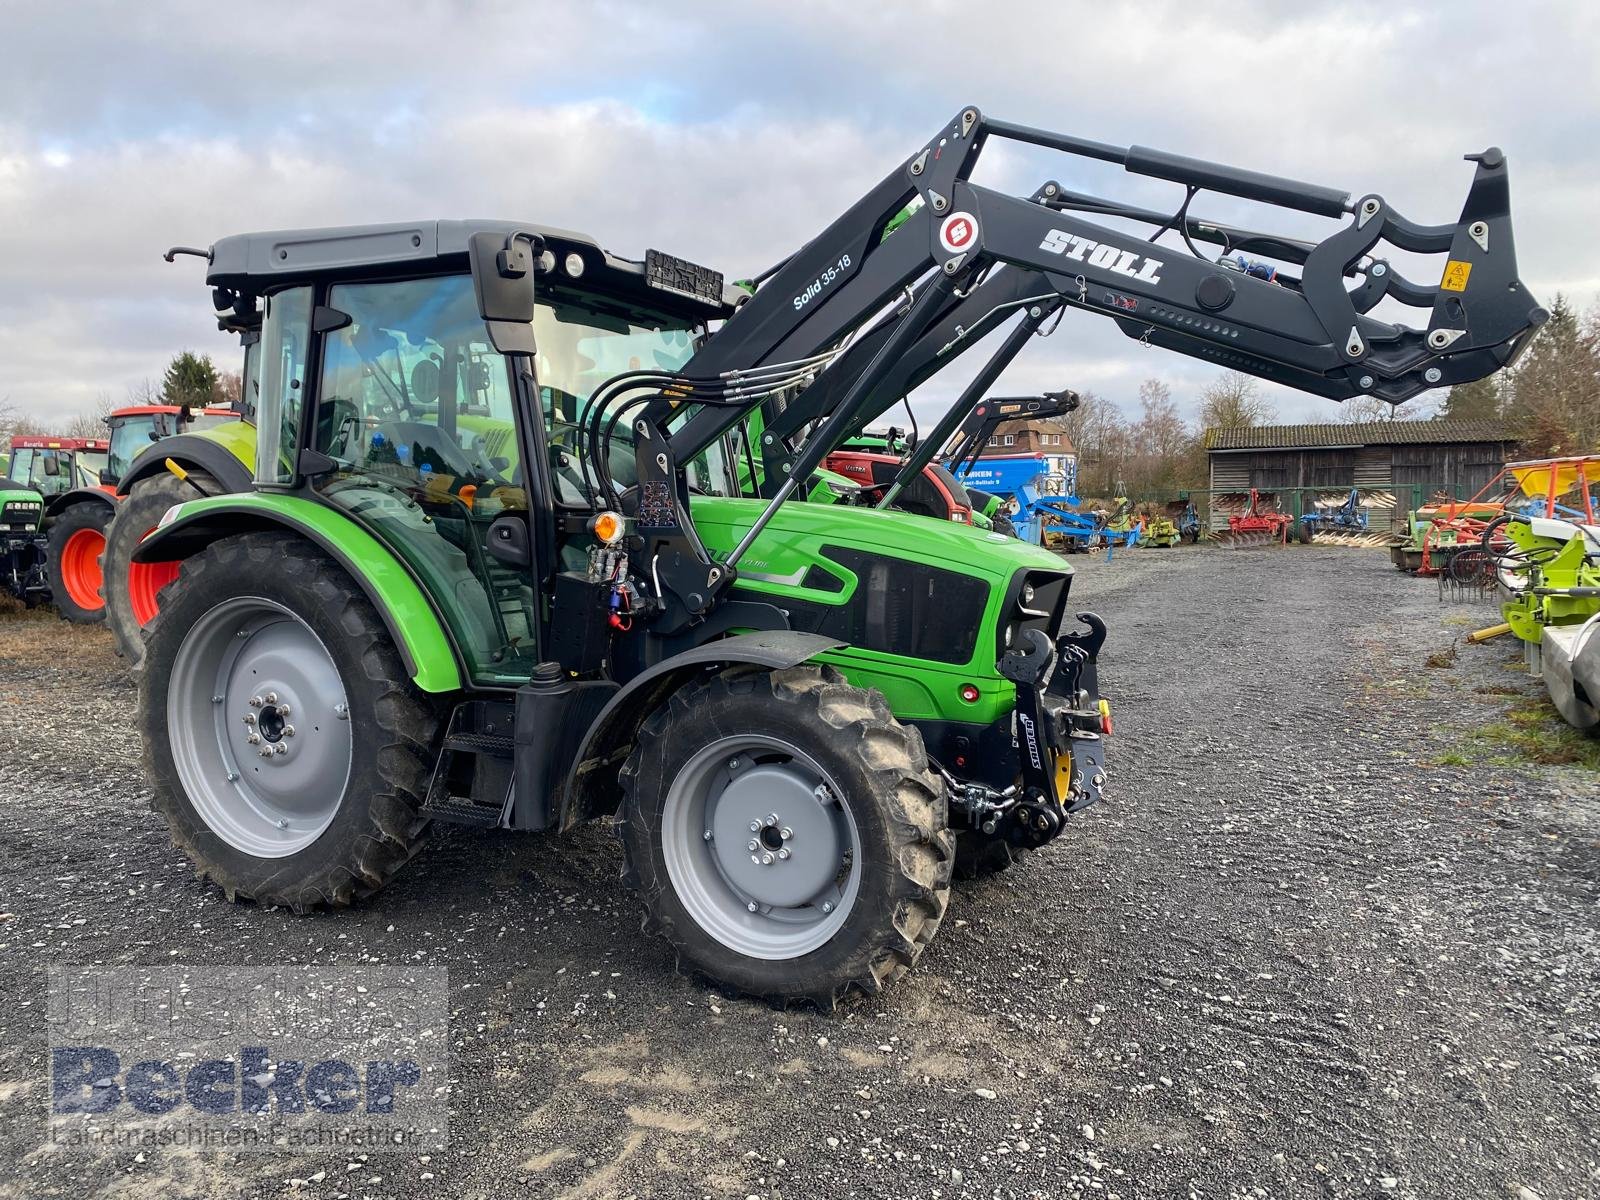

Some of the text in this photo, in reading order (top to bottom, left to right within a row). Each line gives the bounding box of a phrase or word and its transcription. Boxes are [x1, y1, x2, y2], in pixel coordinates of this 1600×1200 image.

[793, 254, 851, 310] Solid 35-18
[1038, 228, 1164, 285] STOLL
[1025, 719, 1042, 770] SAUTER
